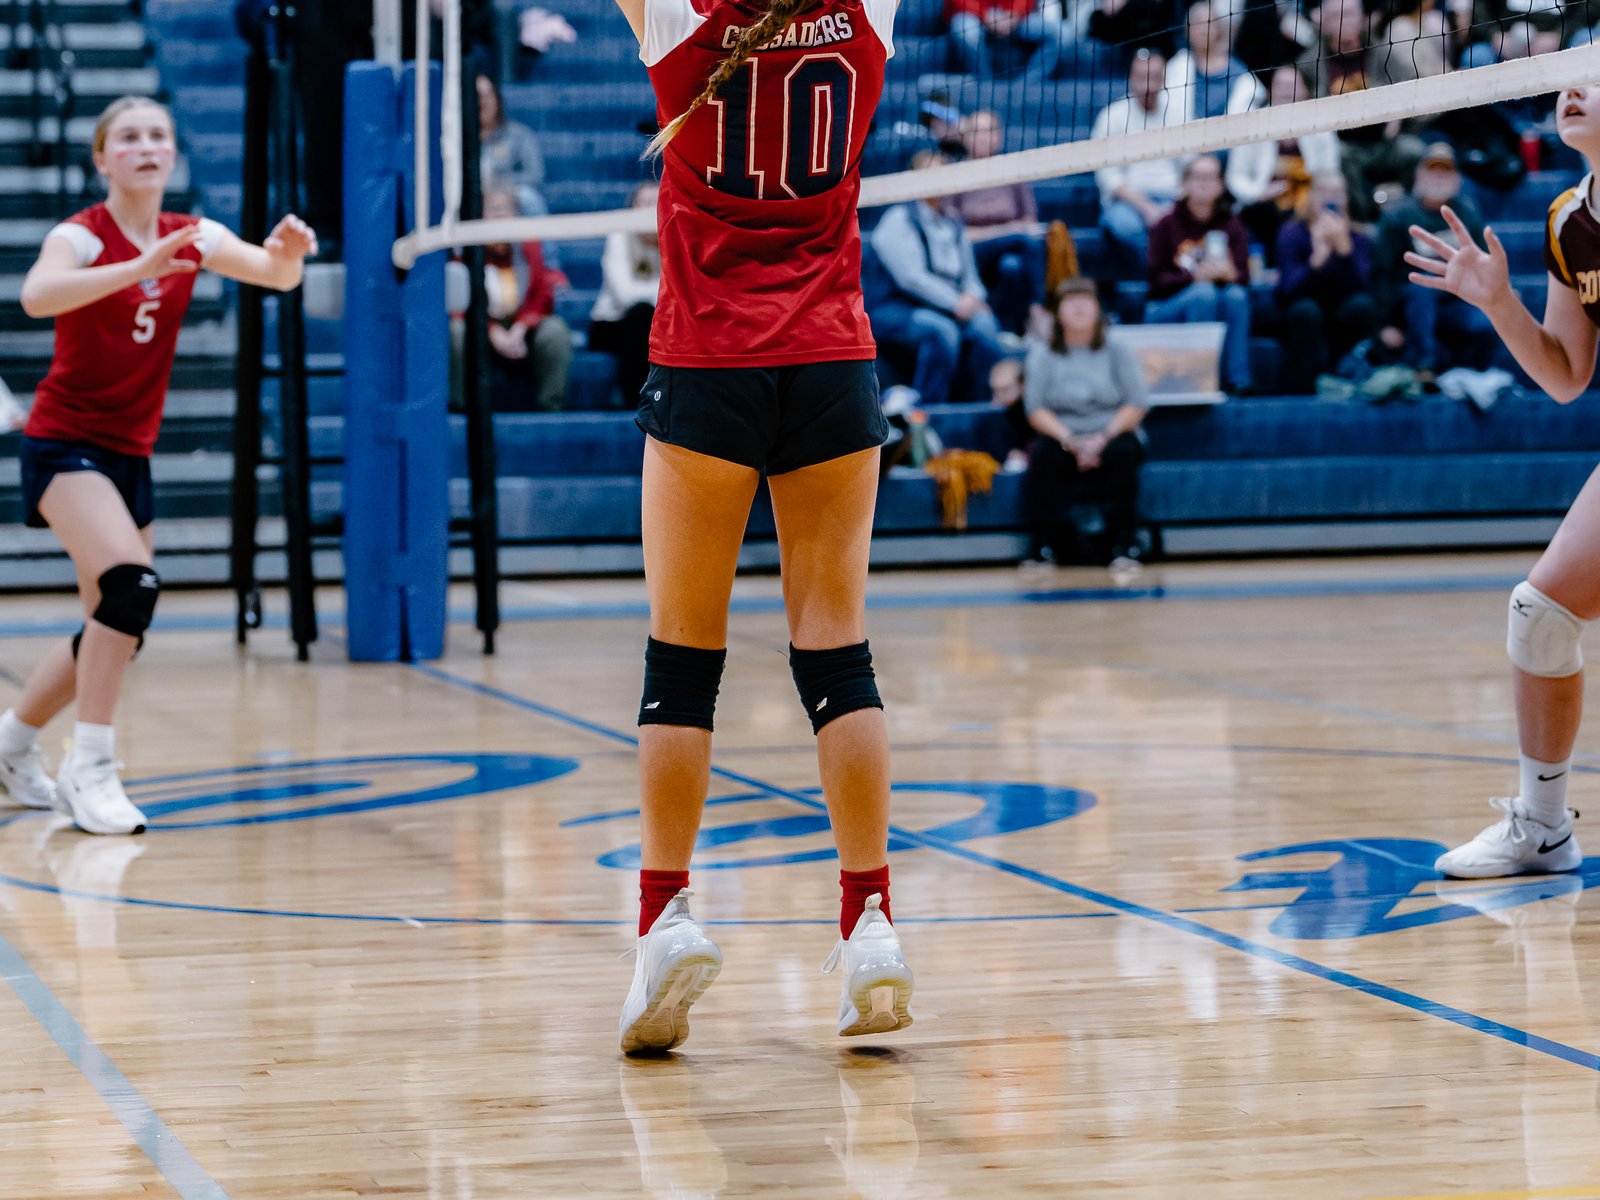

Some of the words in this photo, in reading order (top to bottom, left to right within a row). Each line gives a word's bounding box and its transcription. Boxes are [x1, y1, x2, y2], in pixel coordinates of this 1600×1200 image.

[721, 11, 853, 51] CSADERS
[707, 52, 857, 201] 10
[1575, 269, 1600, 305] CO
[131, 299, 162, 344] 5
